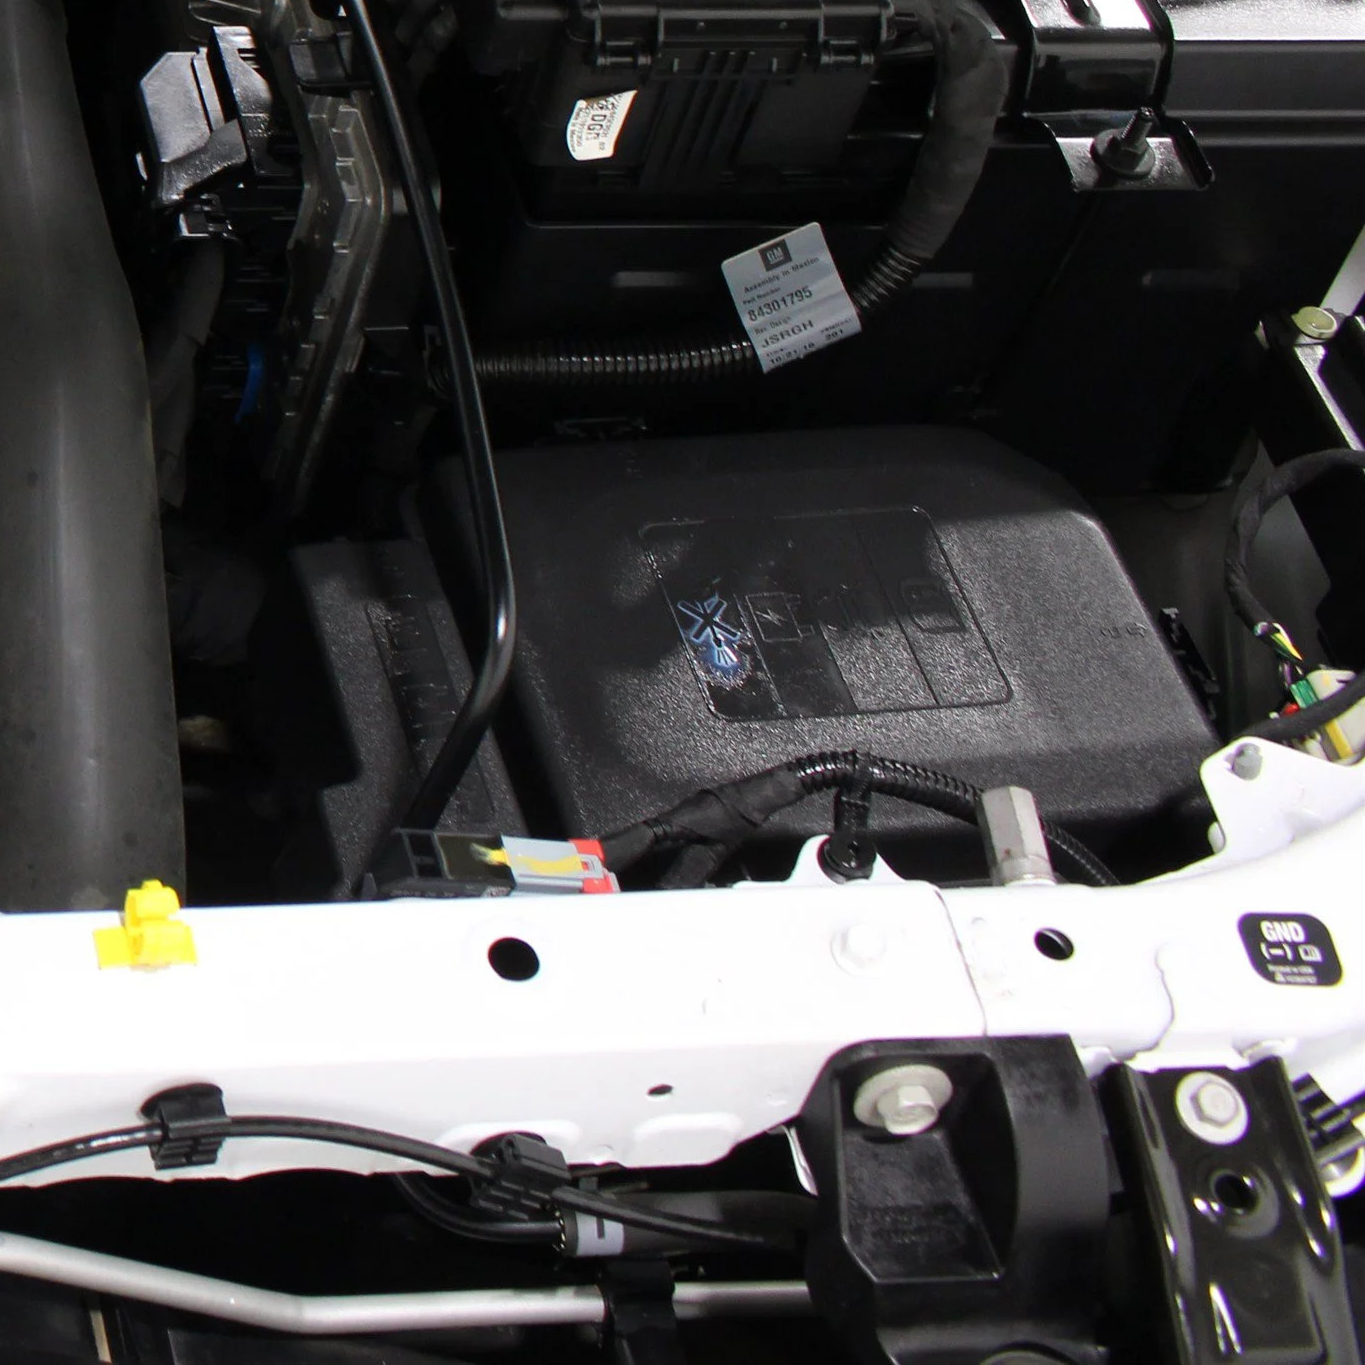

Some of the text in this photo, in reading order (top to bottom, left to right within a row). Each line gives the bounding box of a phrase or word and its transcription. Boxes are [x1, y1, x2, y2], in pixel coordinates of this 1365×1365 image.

[744, 274, 781, 293] Assembly
[791, 256, 820, 272] Mexico
[747, 286, 814, 323] 84301795
[761, 319, 815, 349] JSRGH
[1260, 920, 1305, 942] GND
